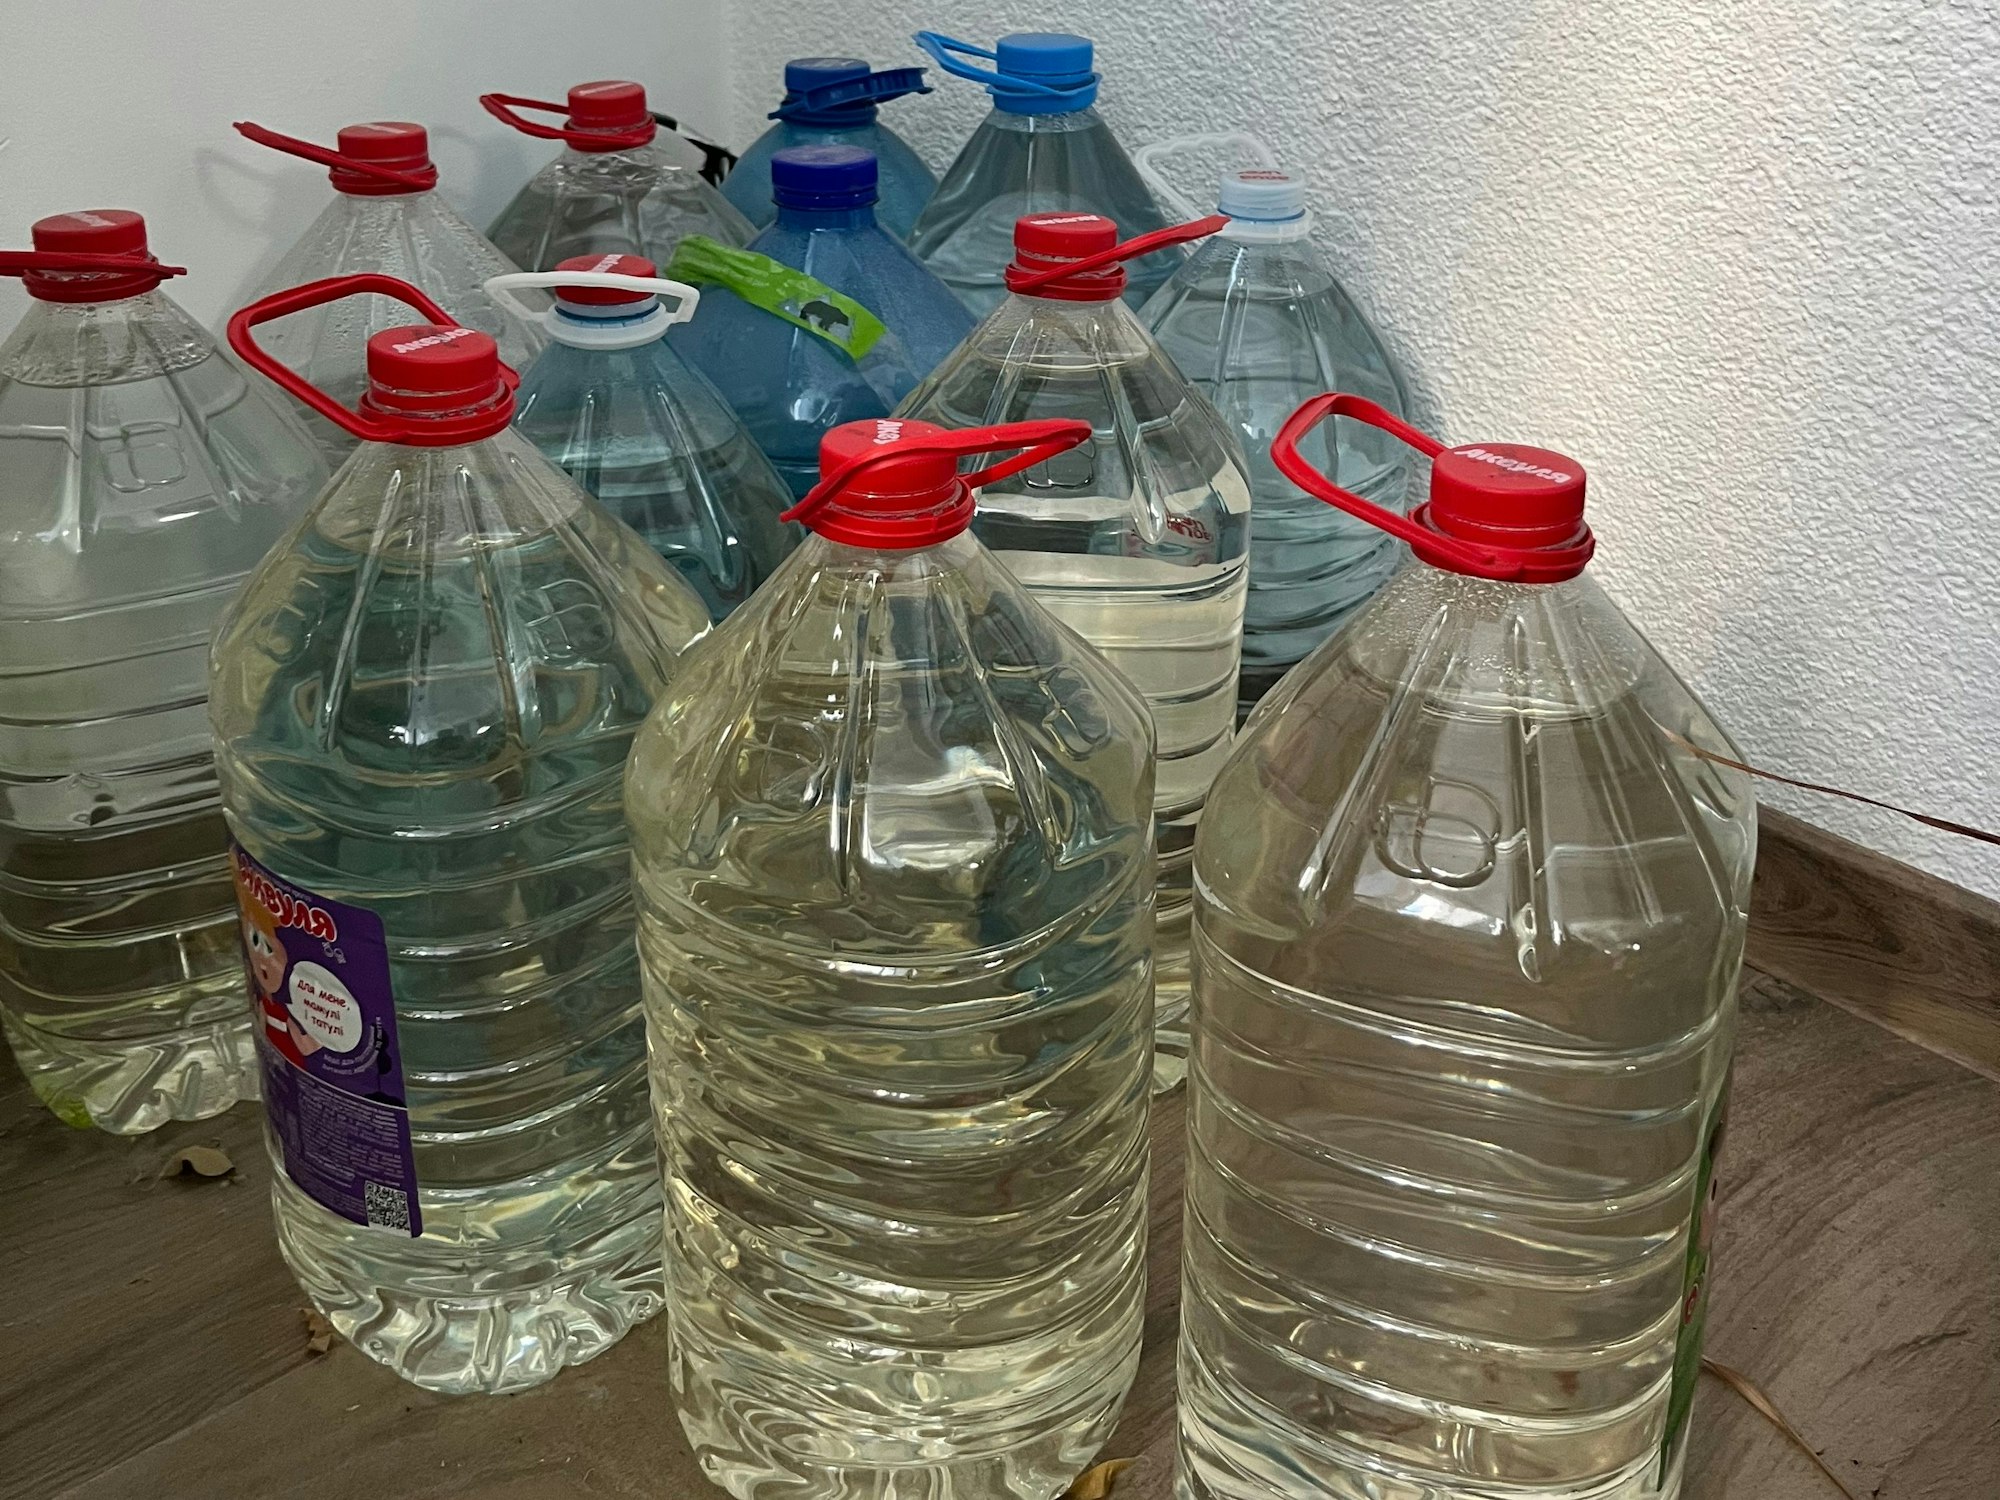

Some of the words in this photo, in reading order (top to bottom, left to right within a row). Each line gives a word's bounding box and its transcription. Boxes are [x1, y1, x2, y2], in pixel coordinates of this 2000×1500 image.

[1454, 448, 1572, 484] Аквуля
[297, 979, 315, 995] для
[311, 1016, 344, 1036] татулі
